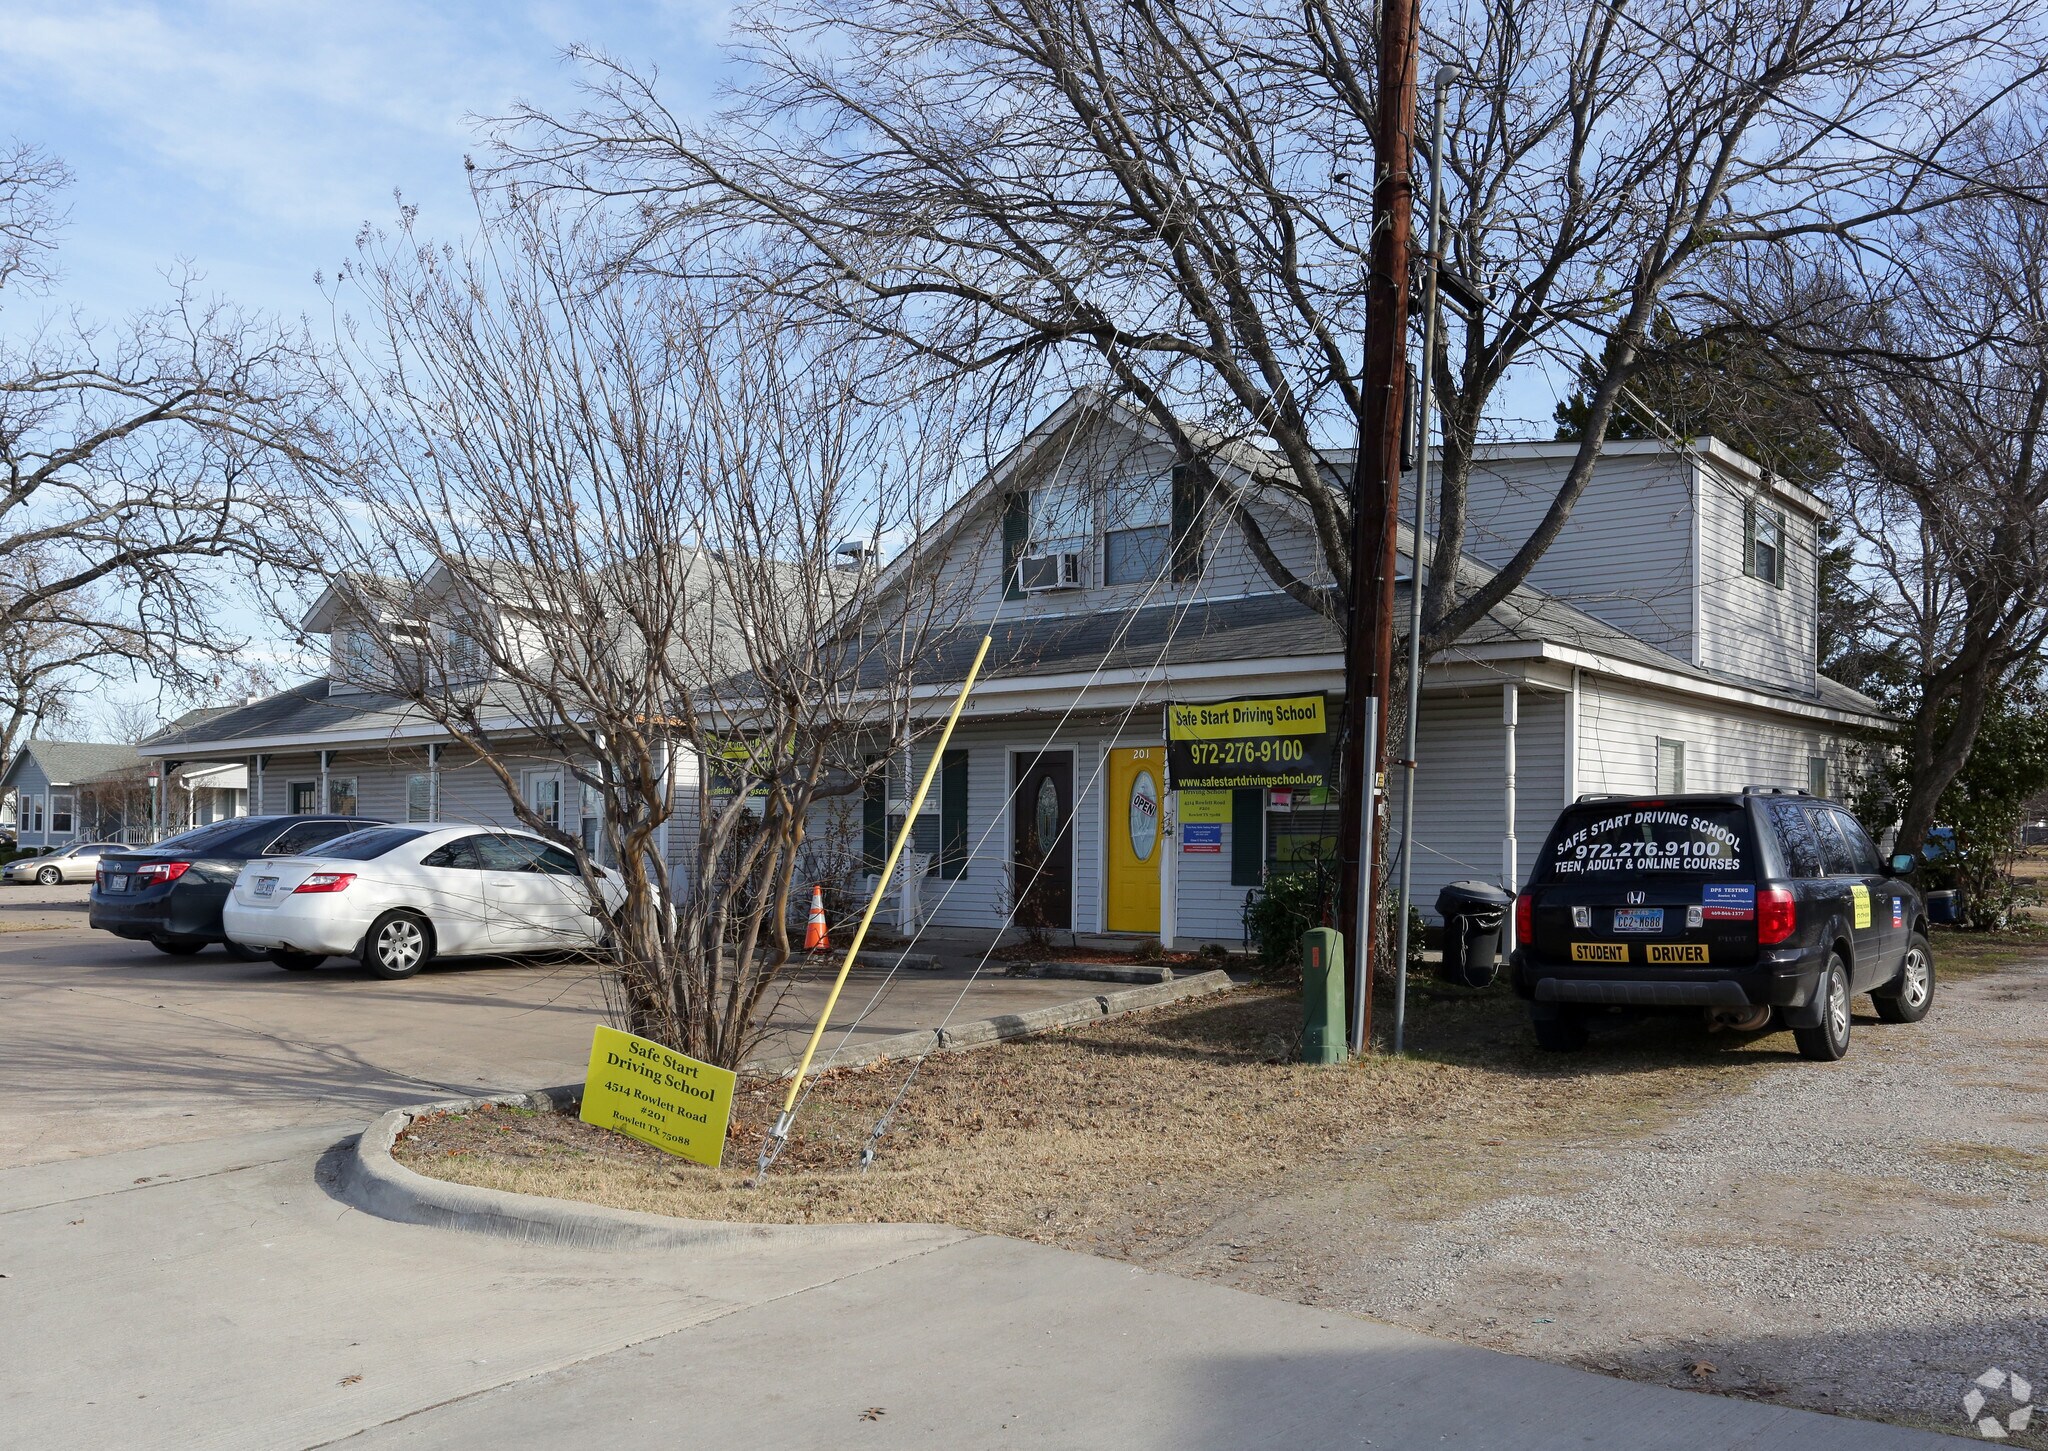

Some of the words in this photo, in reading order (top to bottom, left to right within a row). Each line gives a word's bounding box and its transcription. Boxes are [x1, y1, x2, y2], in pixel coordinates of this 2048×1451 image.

[1176, 710, 1198, 726] Safe
[1200, 708, 1229, 726] Start
[1233, 706, 1274, 725] Driving
[1276, 703, 1317, 720] School
[1133, 748, 1150, 759] 201
[1191, 740, 1303, 765] 972-276-9100
[1178, 772, 1323, 788] www.safestartdrivingschool.org
[1556, 828, 1588, 856] SAFE
[1591, 813, 1632, 836] START
[1634, 811, 1689, 827] DRIVING
[1690, 817, 1741, 853] SCHOOL
[1575, 841, 1720, 860] 972.276.9100
[1555, 861, 1585, 875] TEEN,
[1587, 859, 1623, 871] ADULT
[1625, 858, 1634, 870] &
[1637, 857, 1680, 870] ONLINE
[1683, 858, 1740, 870] COURSES
[1576, 944, 1623, 961] STUDENT
[1652, 946, 1705, 962] DRIVER
[628, 1041, 661, 1063] Safe
[662, 1054, 699, 1079] Start
[607, 1051, 662, 1085] Driving
[664, 1074, 715, 1102] School
[604, 1080, 631, 1097] 4514
[633, 1088, 675, 1112] Rowlett
[676, 1104, 708, 1124] Road
[640, 1106, 667, 1123] #201
[612, 1110, 647, 1130] Rowlett
[648, 1122, 660, 1136] TX
[662, 1130, 691, 1146] 75088
